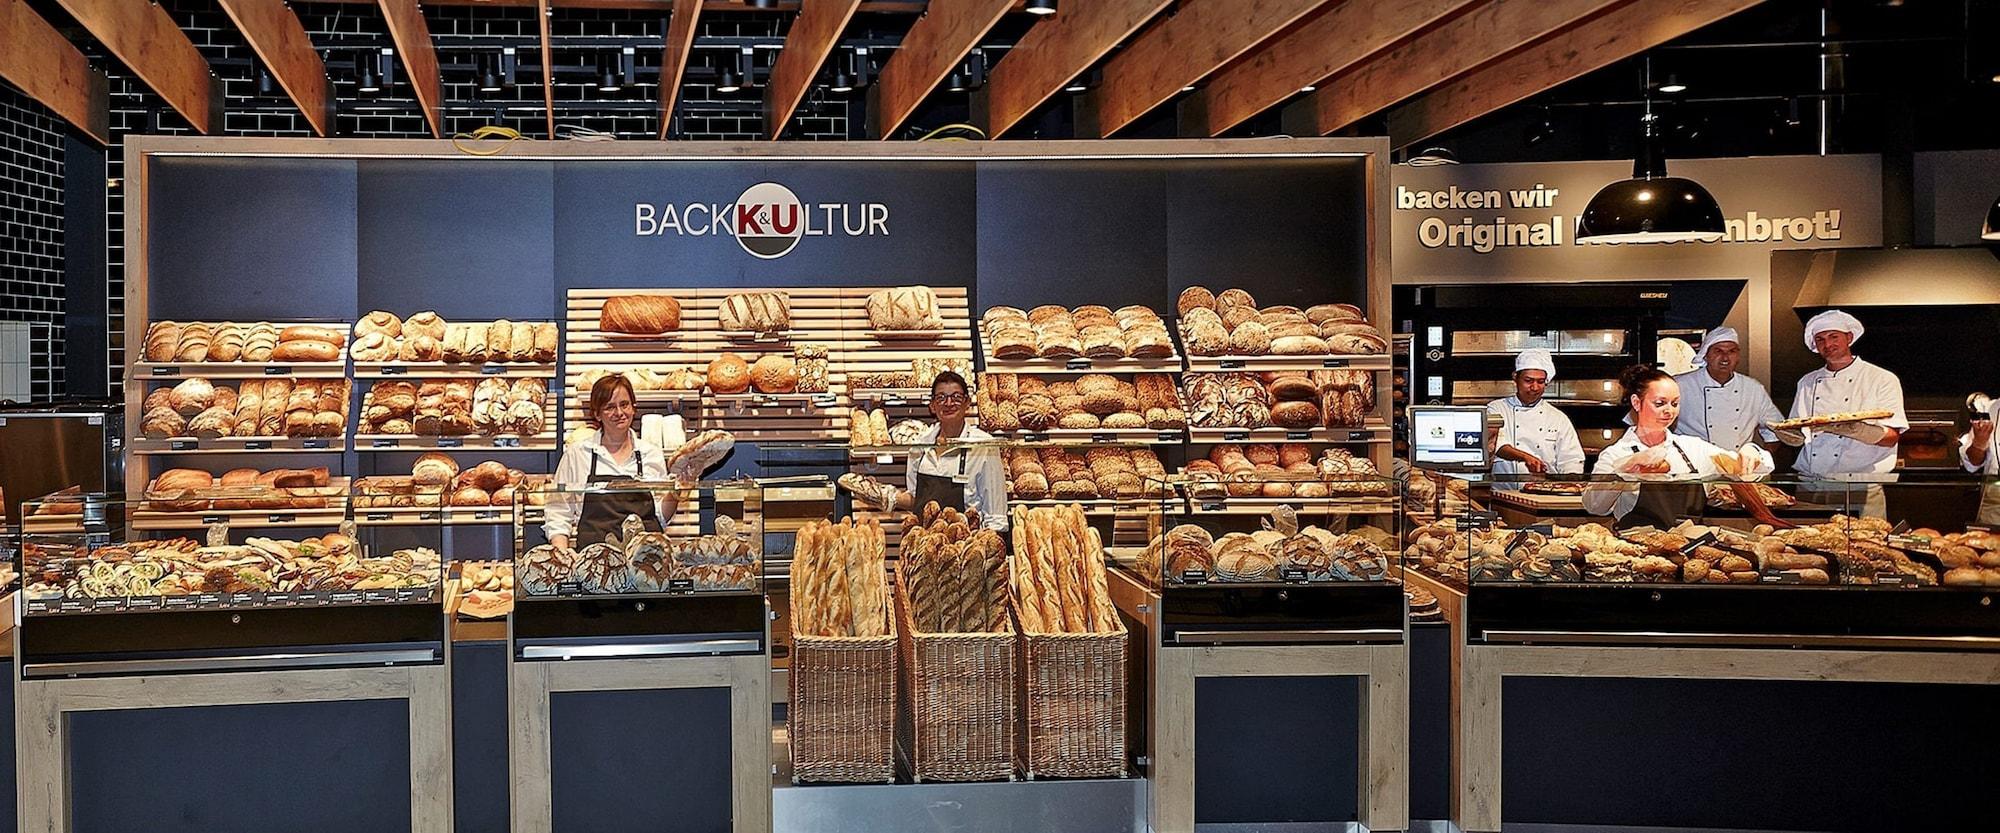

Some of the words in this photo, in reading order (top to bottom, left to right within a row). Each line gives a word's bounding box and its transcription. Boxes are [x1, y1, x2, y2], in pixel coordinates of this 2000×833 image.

[1397, 185, 1502, 209] backen
[1509, 184, 1559, 208] wir
[1418, 215, 1563, 253] Original
